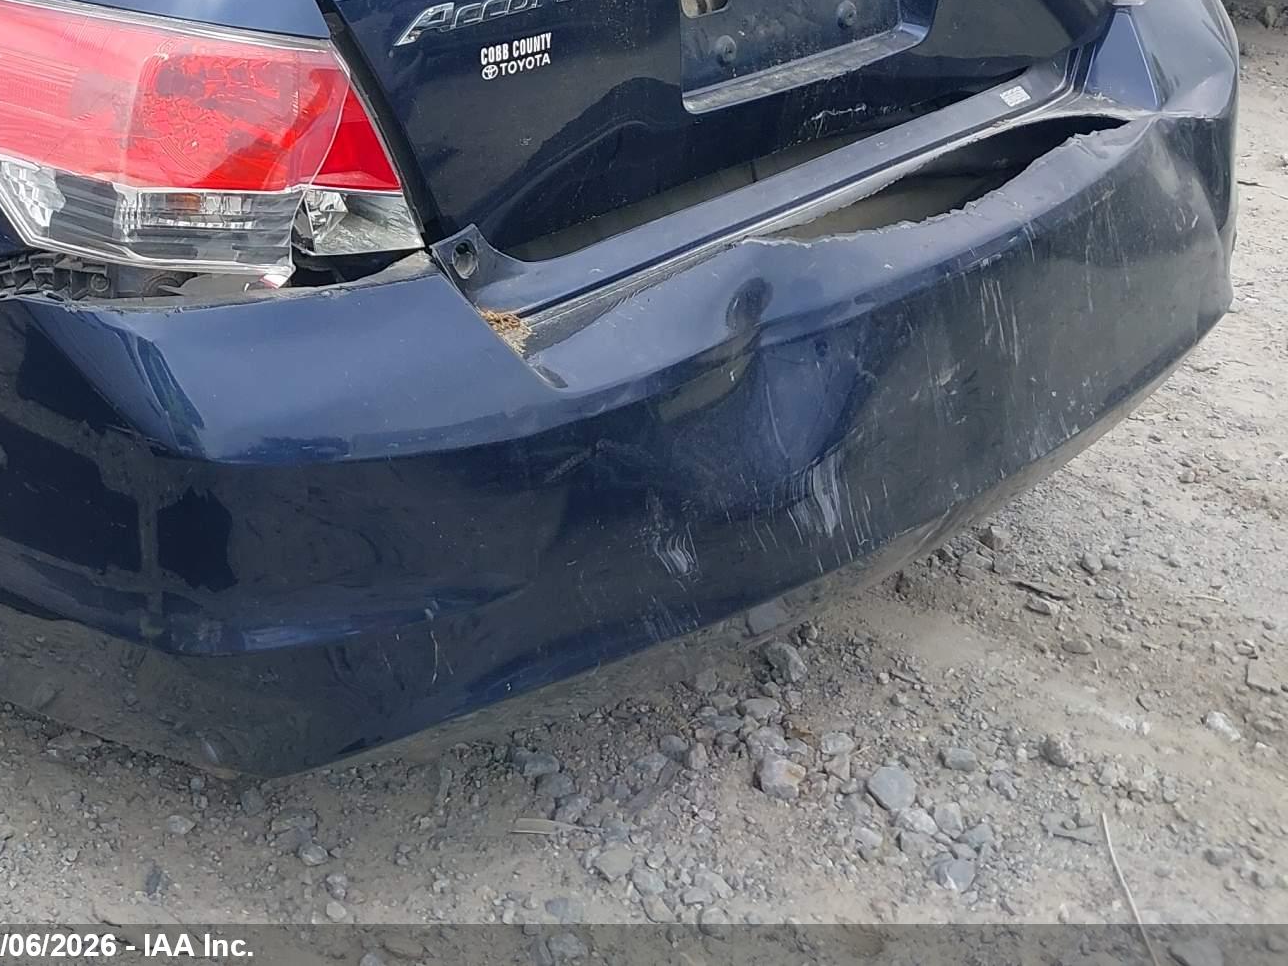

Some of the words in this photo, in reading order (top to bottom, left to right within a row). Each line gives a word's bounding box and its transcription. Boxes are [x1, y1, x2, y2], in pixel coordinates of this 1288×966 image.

[480, 42, 510, 66] COBB
[512, 32, 552, 59] COUNTY
[499, 52, 551, 76] TOYOTA
